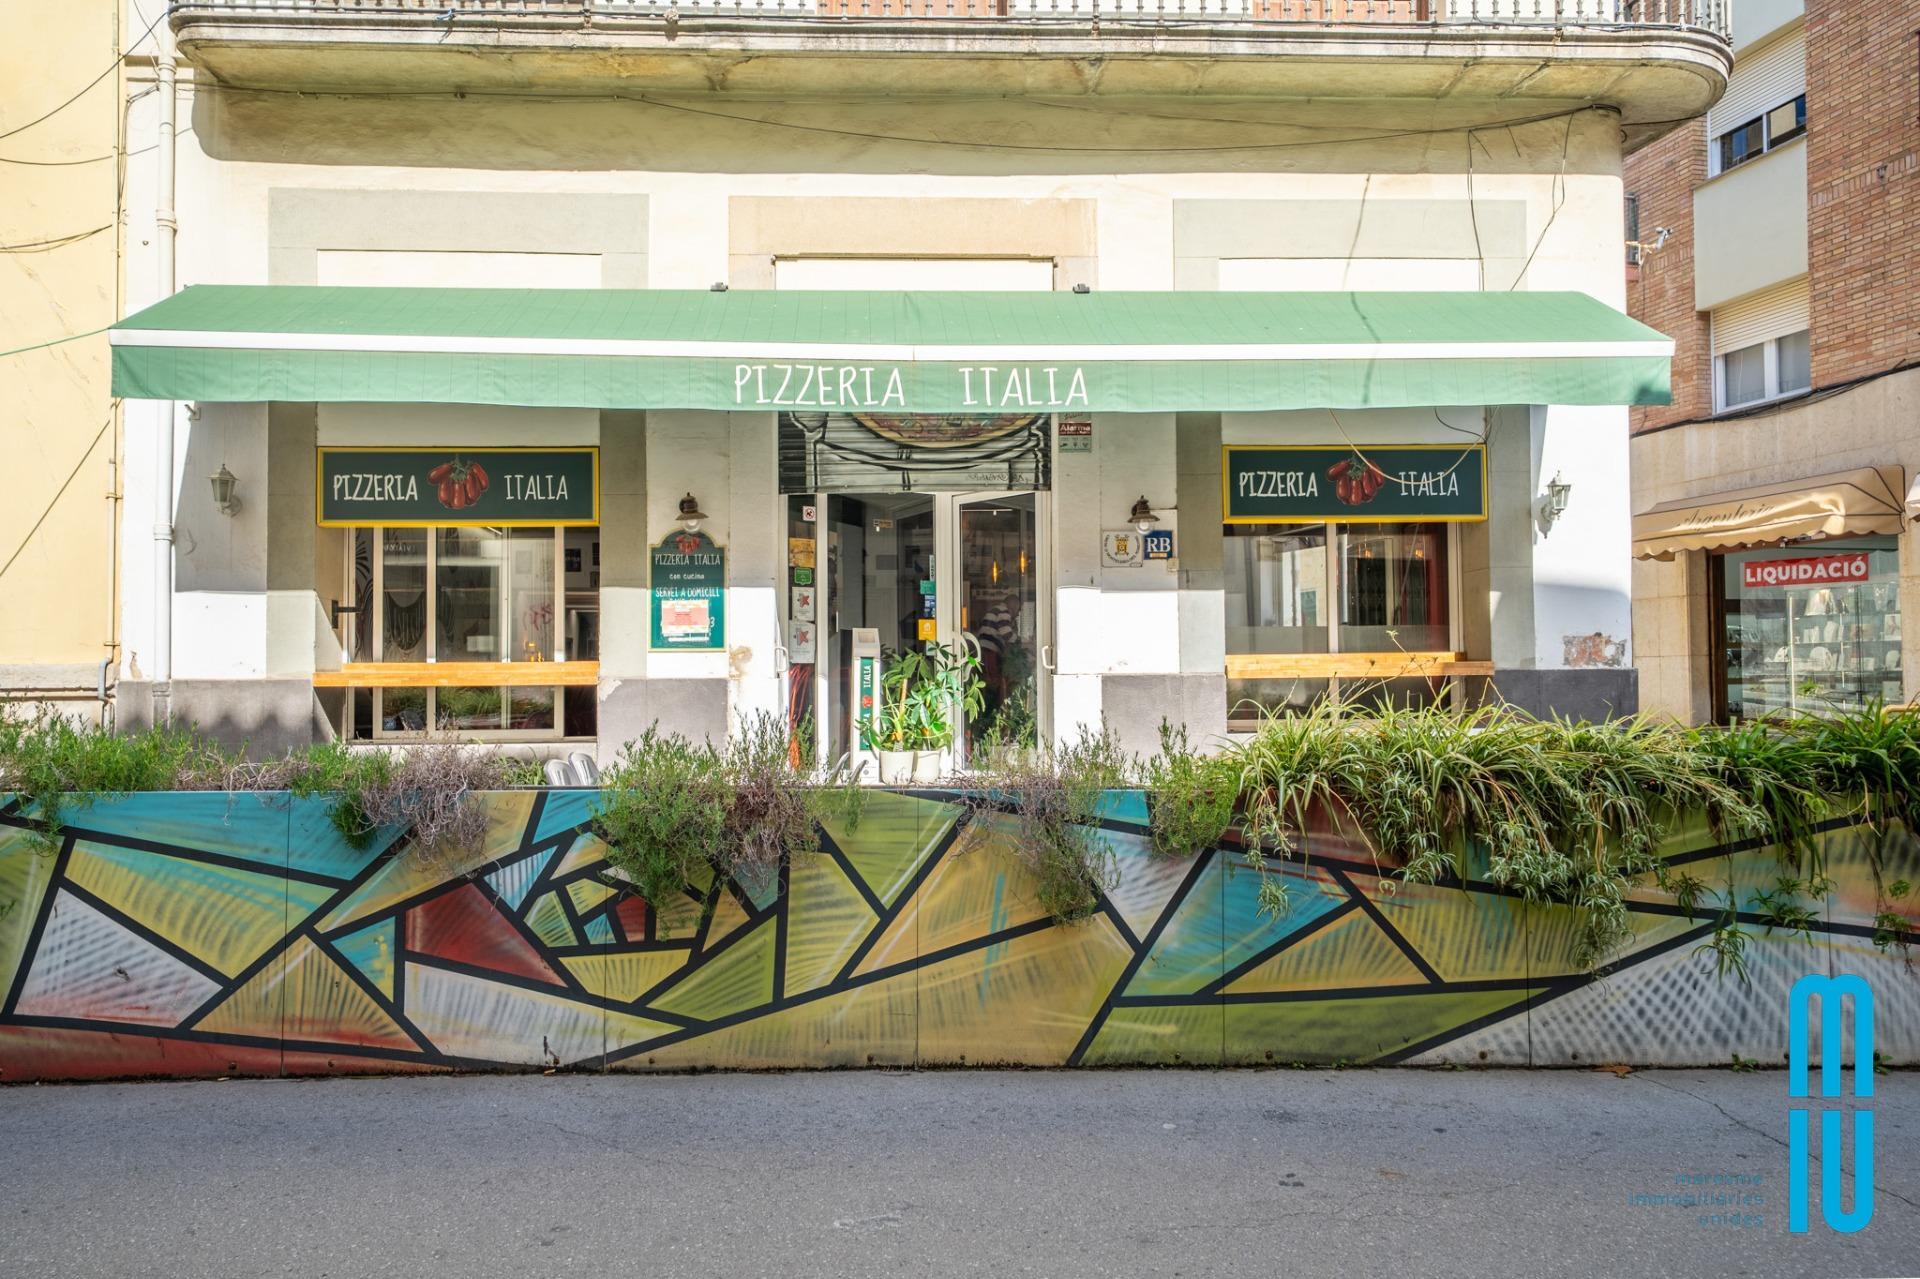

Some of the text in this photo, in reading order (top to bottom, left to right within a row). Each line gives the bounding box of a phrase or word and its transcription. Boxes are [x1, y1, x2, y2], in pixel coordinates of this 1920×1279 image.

[734, 363, 1090, 407] PIZZERIA ITALIA
[1060, 424, 1090, 432] Alarma
[333, 474, 568, 501] PIZZERIA ITALIA
[1239, 471, 1459, 498] PIZZERIA ITALIA
[1147, 537, 1171, 552] RB
[655, 553, 721, 566] PIZZERIA ITALIA
[1745, 556, 1867, 584] LIQUIDACIÓ
[655, 586, 678, 598] SERVEI
[680, 587, 686, 597] A
[863, 665, 871, 688] ITALIA
